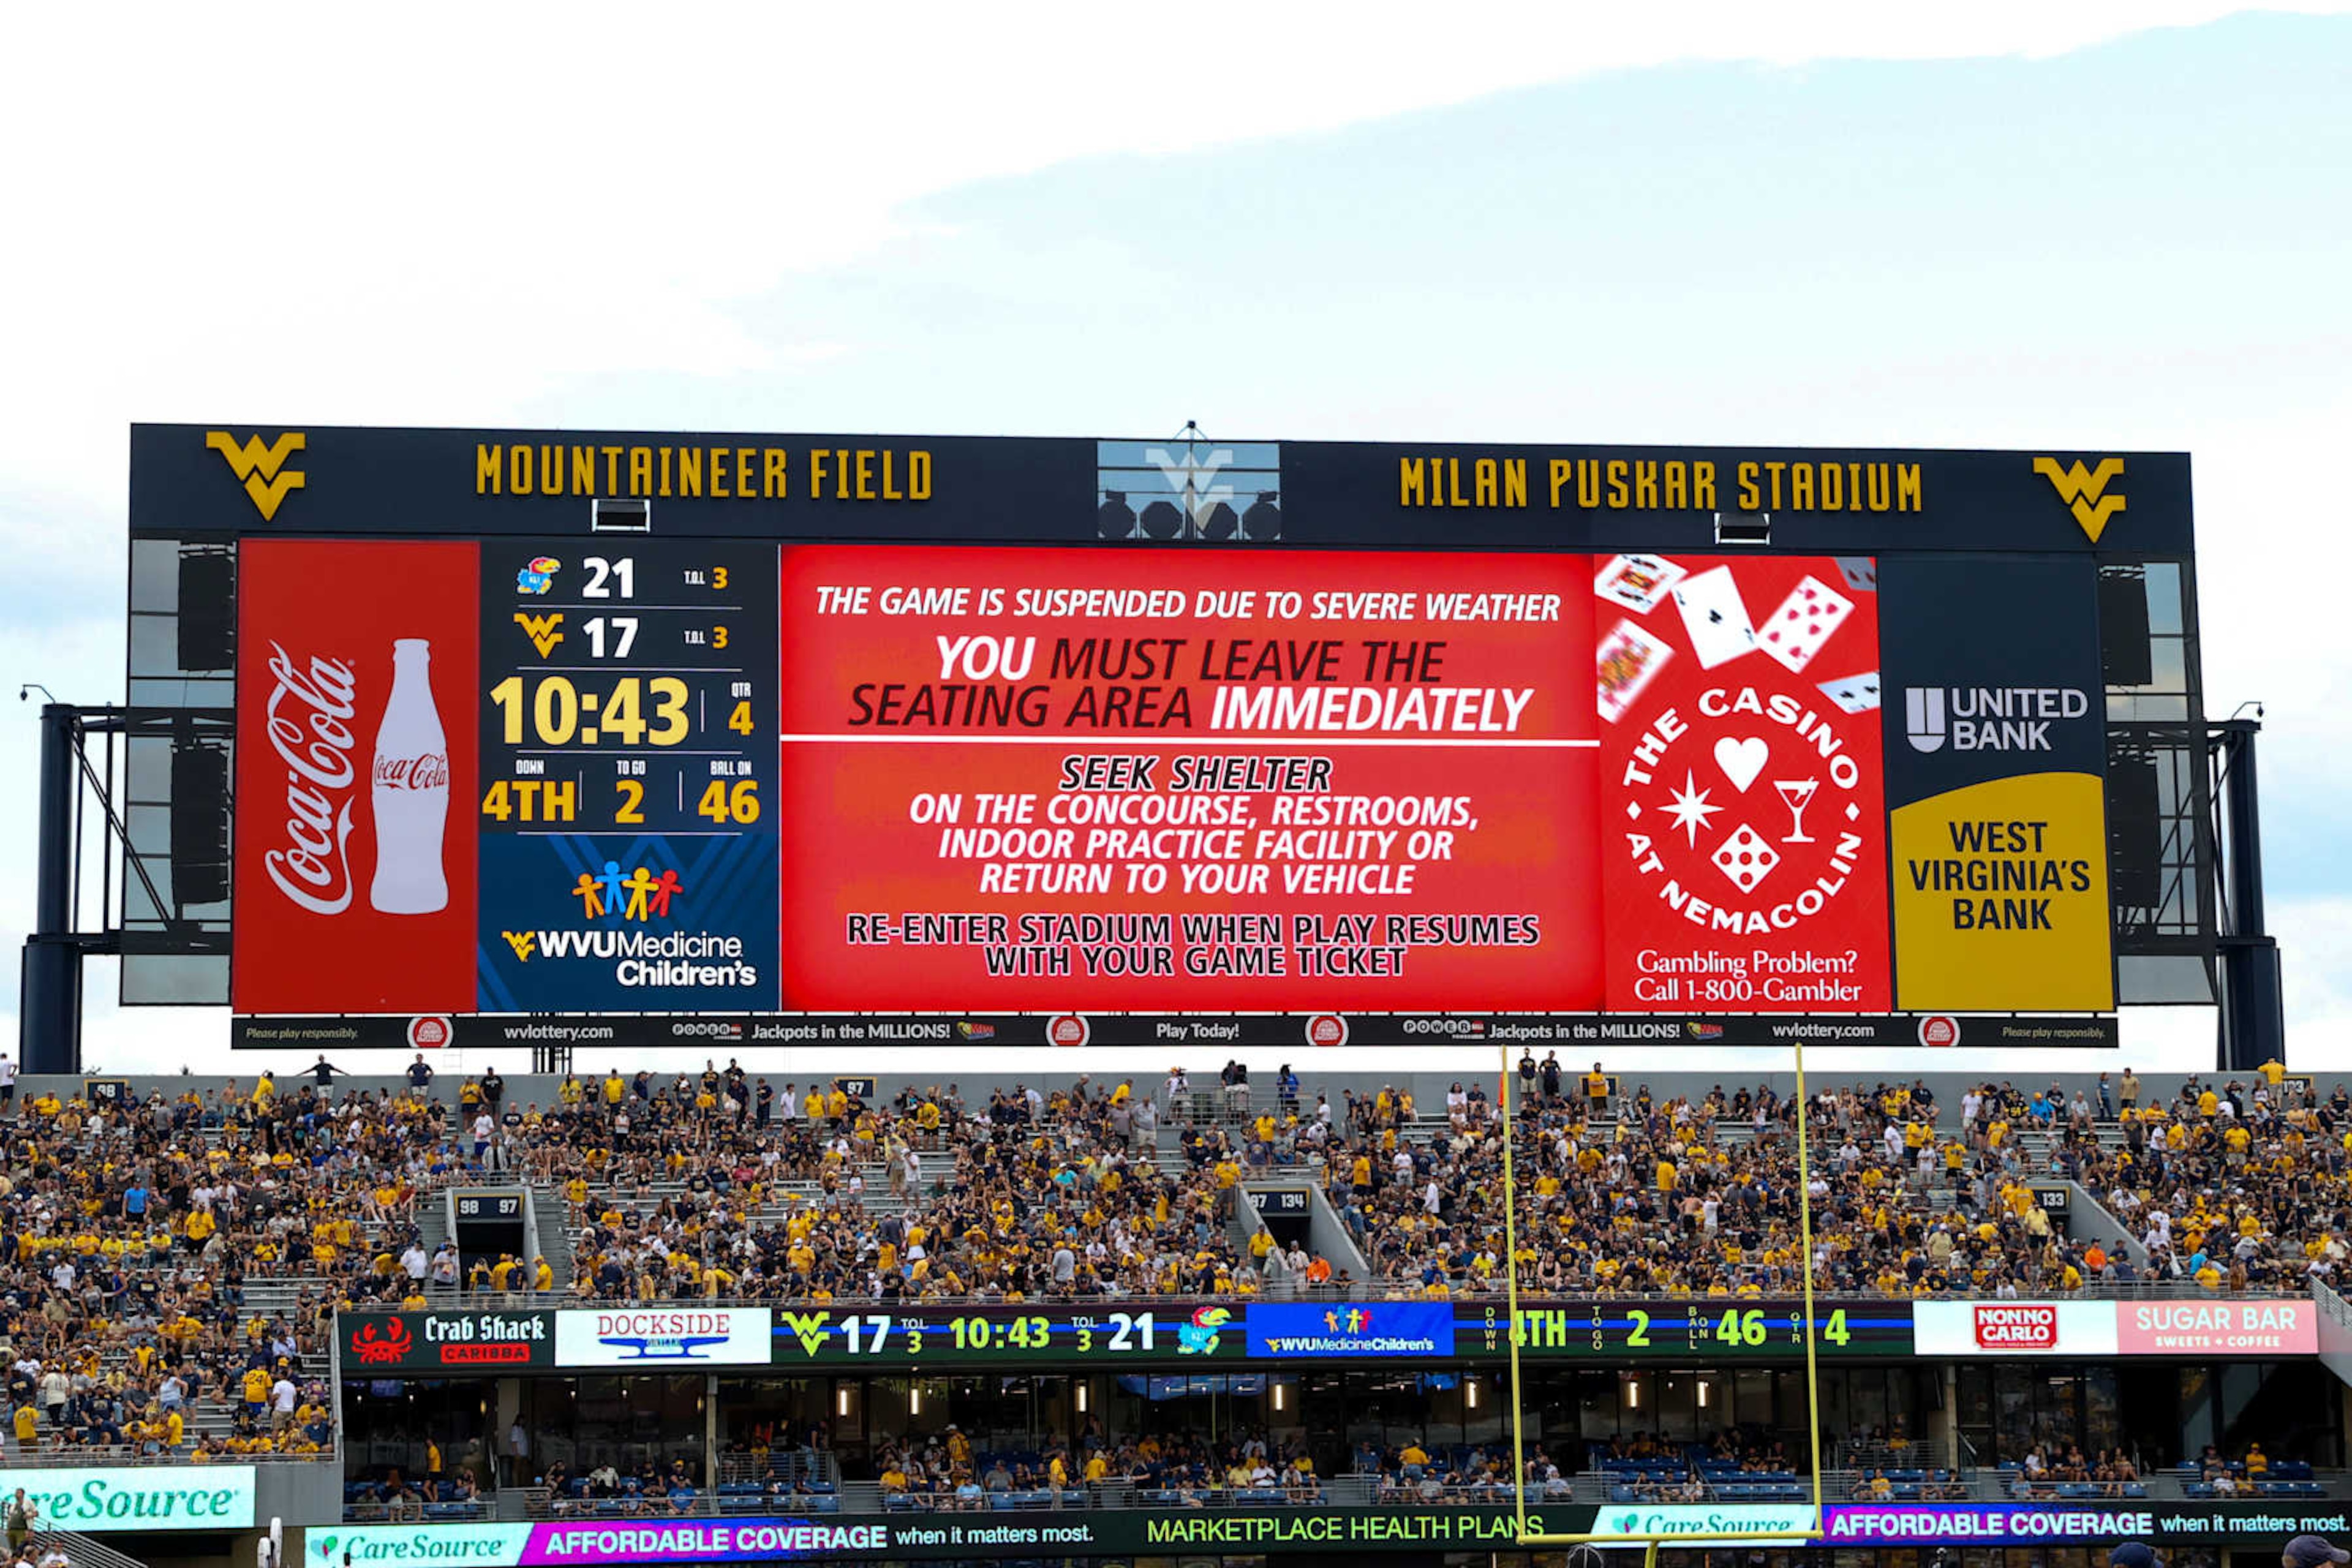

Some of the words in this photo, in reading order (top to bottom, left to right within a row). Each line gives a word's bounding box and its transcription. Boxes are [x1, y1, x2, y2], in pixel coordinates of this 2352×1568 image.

[476, 445, 786, 499] MOUNTAINEER
[810, 449, 932, 500] FIELD
[1400, 458, 1527, 508] MILAN
[1548, 459, 1714, 510] PUSKAR
[1738, 461, 1921, 511] STADIUM
[582, 557, 634, 598] 21
[712, 567, 728, 589] 3
[816, 586, 871, 614] THE
[880, 587, 970, 615] GAME
[978, 588, 1004, 616] IS
[1014, 589, 1186, 618] SUSPENDED
[1195, 591, 1256, 619] DUE
[1265, 592, 1302, 619] TO
[1311, 592, 1417, 620] SEVERE
[1425, 594, 1561, 621] WEATHER
[582, 617, 638, 658] 17
[712, 627, 728, 649] 3
[937, 635, 1035, 680] YOU
[1049, 638, 1186, 680] MUST
[1200, 639, 1343, 681] LEAVE
[1362, 641, 1447, 682] THE
[731, 683, 752, 697] QTR
[1951, 688, 2089, 718] UNITED
[490, 676, 690, 745] 10:43
[728, 701, 755, 735] 4
[848, 684, 1050, 726] SEATING
[1065, 686, 1192, 727] AREA
[1210, 686, 1535, 732] IMMEDIATELY
[1623, 707, 1689, 786] THE
[1698, 687, 1858, 789] CASINO
[1953, 721, 2052, 750] BANK
[265, 639, 355, 915] Coca-Cola
[516, 760, 544, 774] DOWN
[617, 760, 630, 775] TO
[631, 760, 646, 775] GO
[710, 761, 735, 775] BALL
[737, 761, 752, 775] ON
[1058, 755, 1159, 792] SEEK
[1170, 756, 1332, 793] SHELTER
[482, 781, 575, 821] 4TH
[614, 779, 644, 823] 2
[698, 780, 760, 824] 46
[910, 794, 962, 824] ON
[976, 794, 1036, 824] THE
[1047, 795, 1257, 829] CONCOURSE,
[1272, 796, 1479, 831] RESTROOMS,
[939, 828, 1074, 858] INDOOR
[1085, 829, 1243, 859] PRACTICE
[1255, 830, 1398, 859] FACILITY
[1408, 831, 1454, 860] OR
[1949, 822, 2047, 853] WEST
[979, 864, 1112, 893] RETURN
[1126, 864, 1167, 893] TO
[1181, 864, 1269, 894] YOUR
[1283, 864, 1416, 894] VEHICLE
[1626, 832, 1664, 874] AT
[1659, 831, 1862, 935] NEMACOLIN
[1909, 860, 2090, 891] VIRGINIA'S
[846, 914, 1008, 944] RE-ENTER
[1019, 914, 1172, 944] STADIUM
[1181, 914, 1282, 944] WHEN
[1293, 915, 1378, 945] PLAY
[1386, 915, 1540, 945] RESUMES
[1953, 899, 2052, 930] BANK
[984, 946, 1072, 976] WITH
[1081, 946, 1174, 976] YOUR
[1185, 946, 1286, 976] GAME
[1295, 946, 1408, 976] TICKET
[1637, 949, 1746, 979] Gambling
[1753, 950, 1858, 973] Problem?
[1634, 977, 1679, 1001] Call
[1686, 978, 1862, 1001] 1-800-Gambler
[246, 1027, 277, 1038] Please
[279, 1027, 301, 1039] play
[302, 1027, 358, 1040] responsibly.
[504, 1023, 613, 1041] wvlottery.com
[752, 1023, 819, 1041] Jackpots
[821, 1024, 837, 1038] in
[839, 1024, 864, 1038] the
[868, 1023, 951, 1039] MILLIONS!
[1156, 1023, 1188, 1039] Play
[1191, 1023, 1239, 1040] Today!
[1489, 1023, 1552, 1041] Jackpots
[1556, 1024, 1569, 1038] in
[1573, 1024, 1597, 1038] the
[1600, 1023, 1681, 1039] MILLIONS!
[1773, 1023, 1874, 1039] wvlottery.com
[2002, 1026, 2032, 1037] Please
[2032, 1026, 2051, 1039] play
[2054, 1027, 2106, 1039] responsibly.
[460, 1200, 479, 1213] 98
[499, 1199, 517, 1213] 97
[1250, 1194, 1267, 1208] 97
[1281, 1194, 1304, 1208] 134
[2042, 1193, 2064, 1207] 133
[425, 1315, 473, 1341] Crab
[480, 1314, 546, 1341] Shack
[597, 1314, 730, 1335] DOCKSIDE
[1107, 1313, 1153, 1351] 21
[1485, 1306, 1496, 1351] DOWN
[1509, 1310, 1566, 1347] 4TH
[1627, 1310, 1650, 1347] 2
[1716, 1309, 1766, 1346] 46
[1824, 1309, 1850, 1346] 4
[1978, 1309, 2052, 1325] NONNO
[2136, 1306, 2232, 1332] SUGAR
[2242, 1306, 2296, 1330] BAR
[839, 1316, 891, 1354] 17
[907, 1330, 922, 1354] 3
[949, 1317, 1050, 1349] 10:43
[1076, 1329, 1092, 1352] 3
[1982, 1325, 2049, 1341] CARLO
[2155, 1336, 2210, 1347] SWEETS
[2228, 1336, 2280, 1347] COFFEE
[1147, 1518, 1343, 1543] MARKETPLACE
[1351, 1516, 1450, 1540] HEALTH
[1458, 1515, 1545, 1539] PLANS
[1831, 1514, 2003, 1536] AFFORDABLE
[2010, 1512, 2154, 1535] COVERAGE
[2160, 1515, 2209, 1532] when
[2212, 1514, 2223, 1531] it
[2229, 1515, 2294, 1532] matters
[2300, 1515, 2350, 1532] most.
[344, 1534, 502, 1559] CareSource
[546, 1529, 728, 1555] AFFORDABLE
[736, 1526, 887, 1551] COVERAGE
[895, 1527, 946, 1544] when
[950, 1527, 962, 1543] it
[966, 1526, 1037, 1544] matters
[1042, 1525, 1093, 1542] most.
